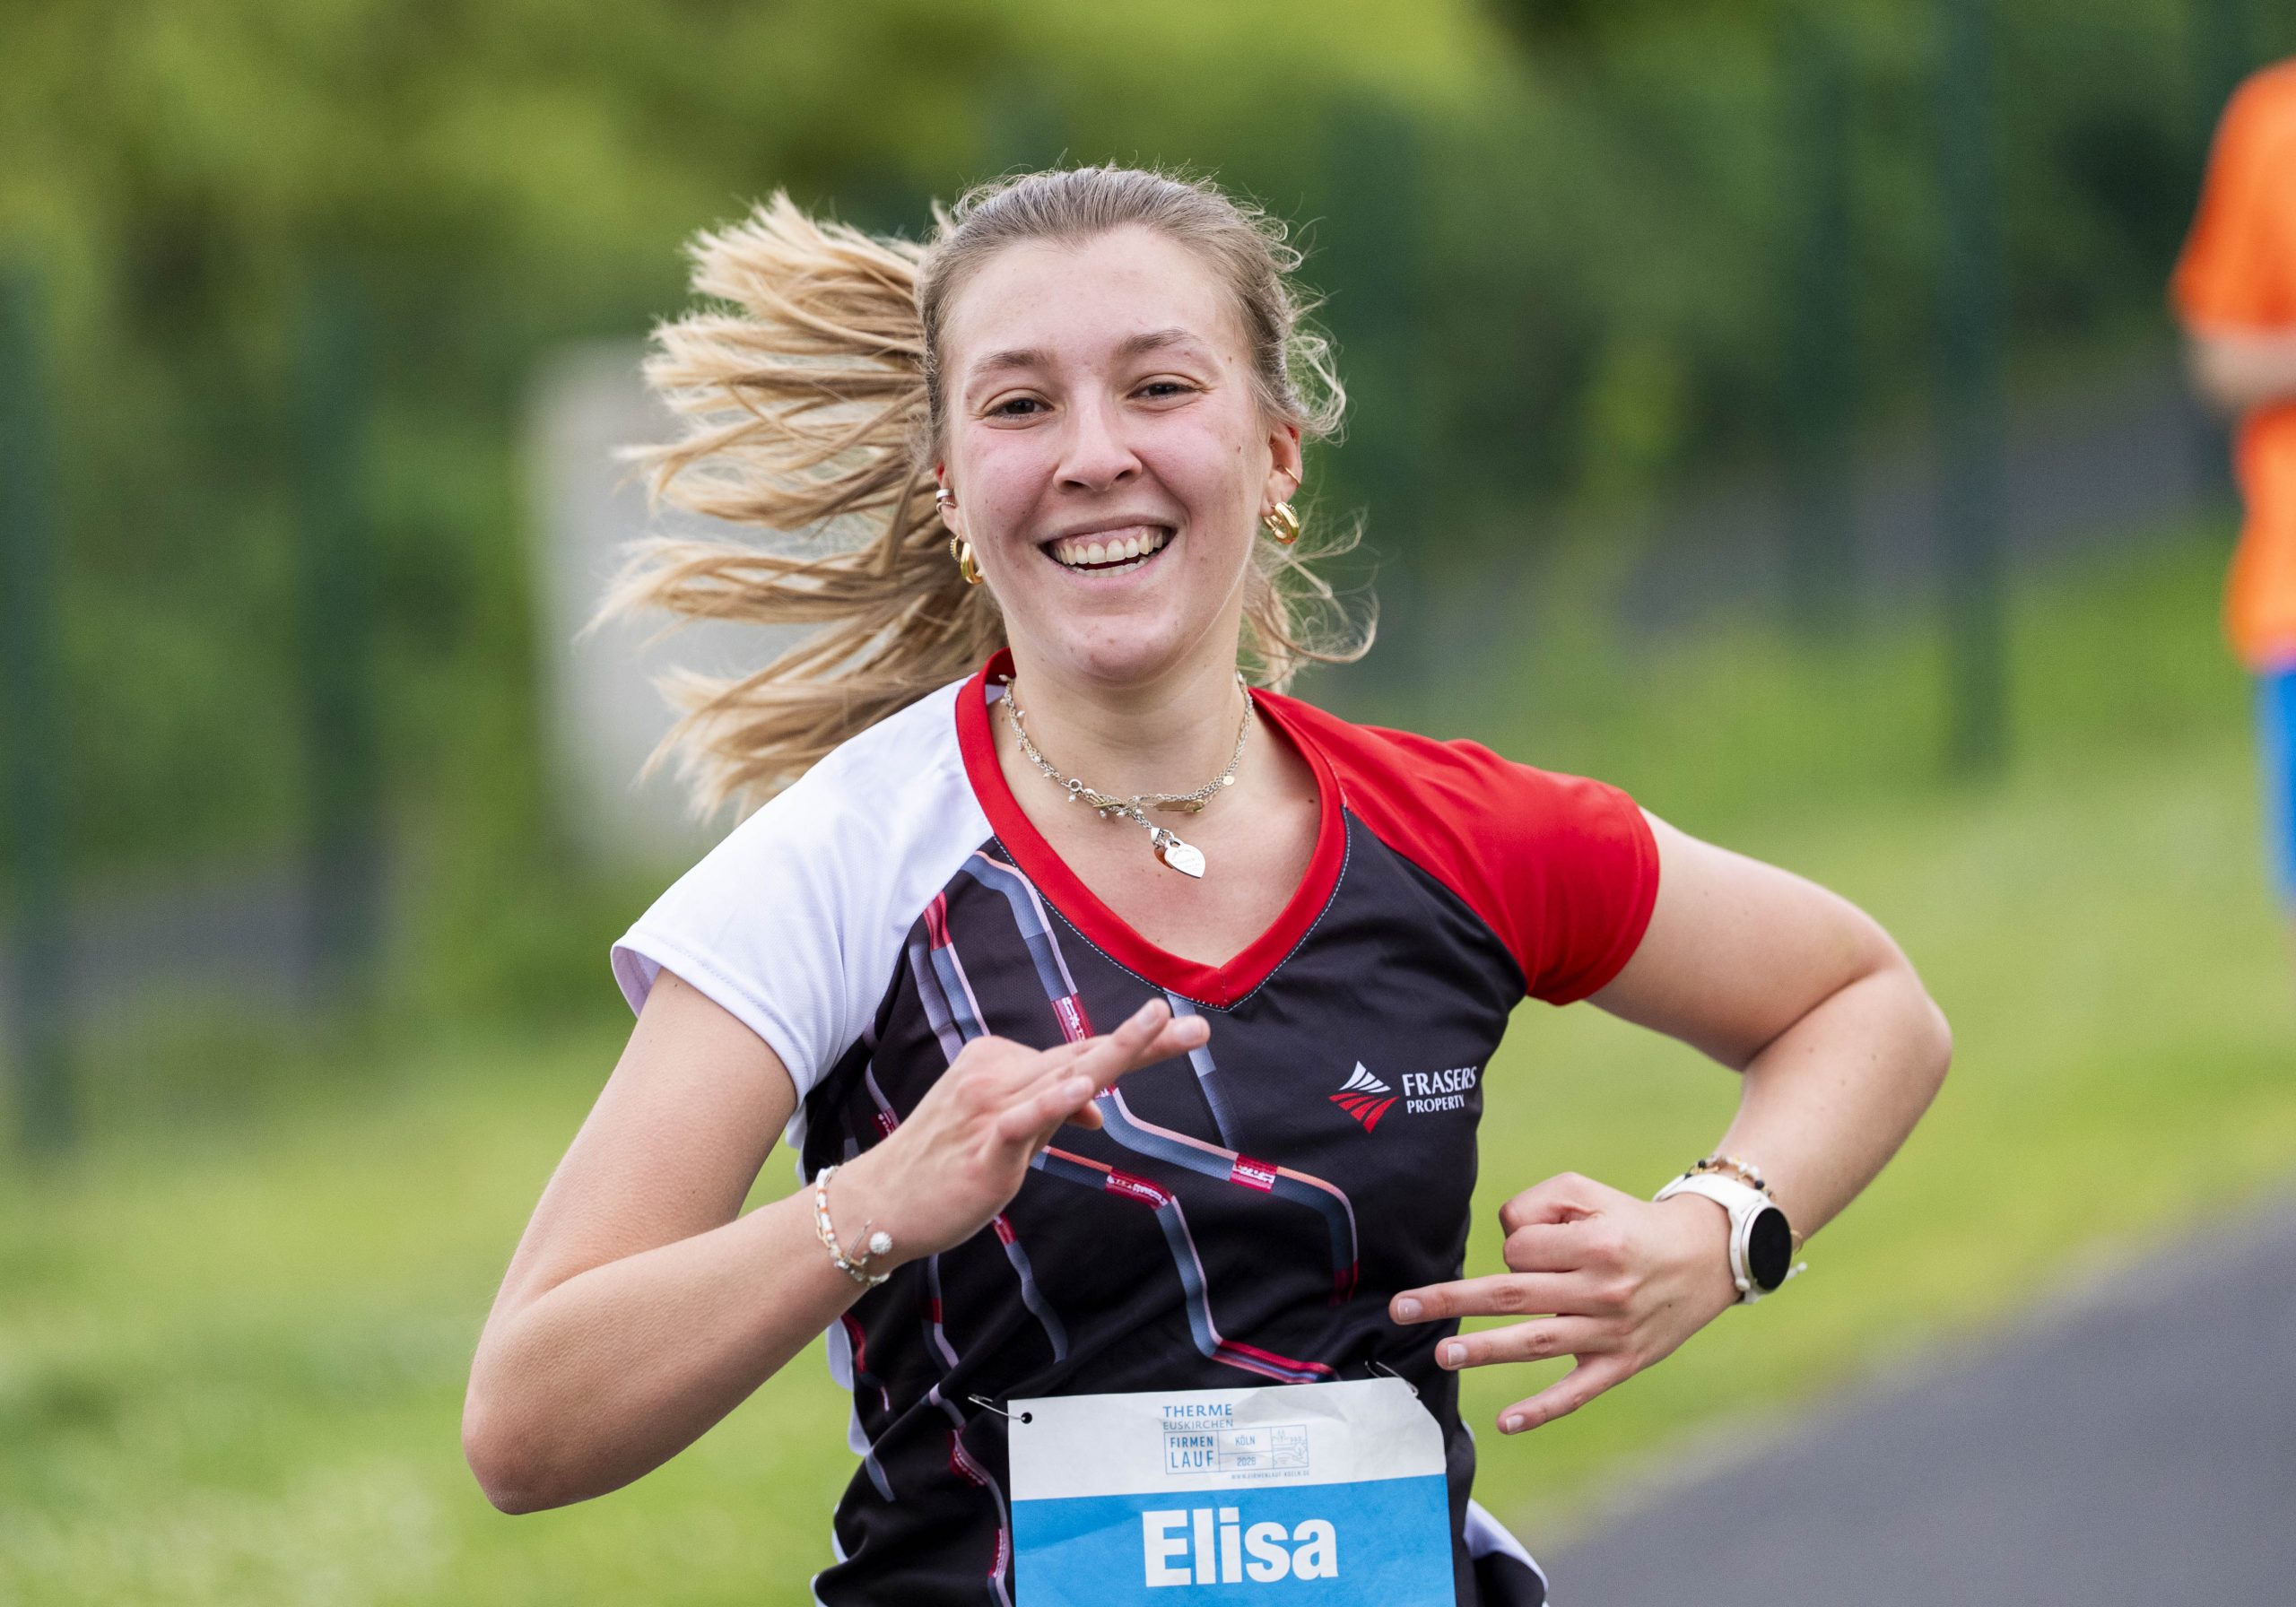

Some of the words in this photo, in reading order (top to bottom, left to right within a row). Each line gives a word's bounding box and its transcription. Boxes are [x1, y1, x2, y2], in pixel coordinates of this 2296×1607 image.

[1402, 1066, 1477, 1097] FRASERS
[1406, 1094, 1465, 1114] PROPERTY
[1162, 1403, 1233, 1419] THERME
[1162, 1419, 1234, 1431] EUSKIRCHEN
[1170, 1436, 1213, 1448] FIRMEN
[1235, 1434, 1256, 1446] KÖLN
[1170, 1450, 1213, 1469] LAUF
[1142, 1507, 1339, 1588] Elisa
